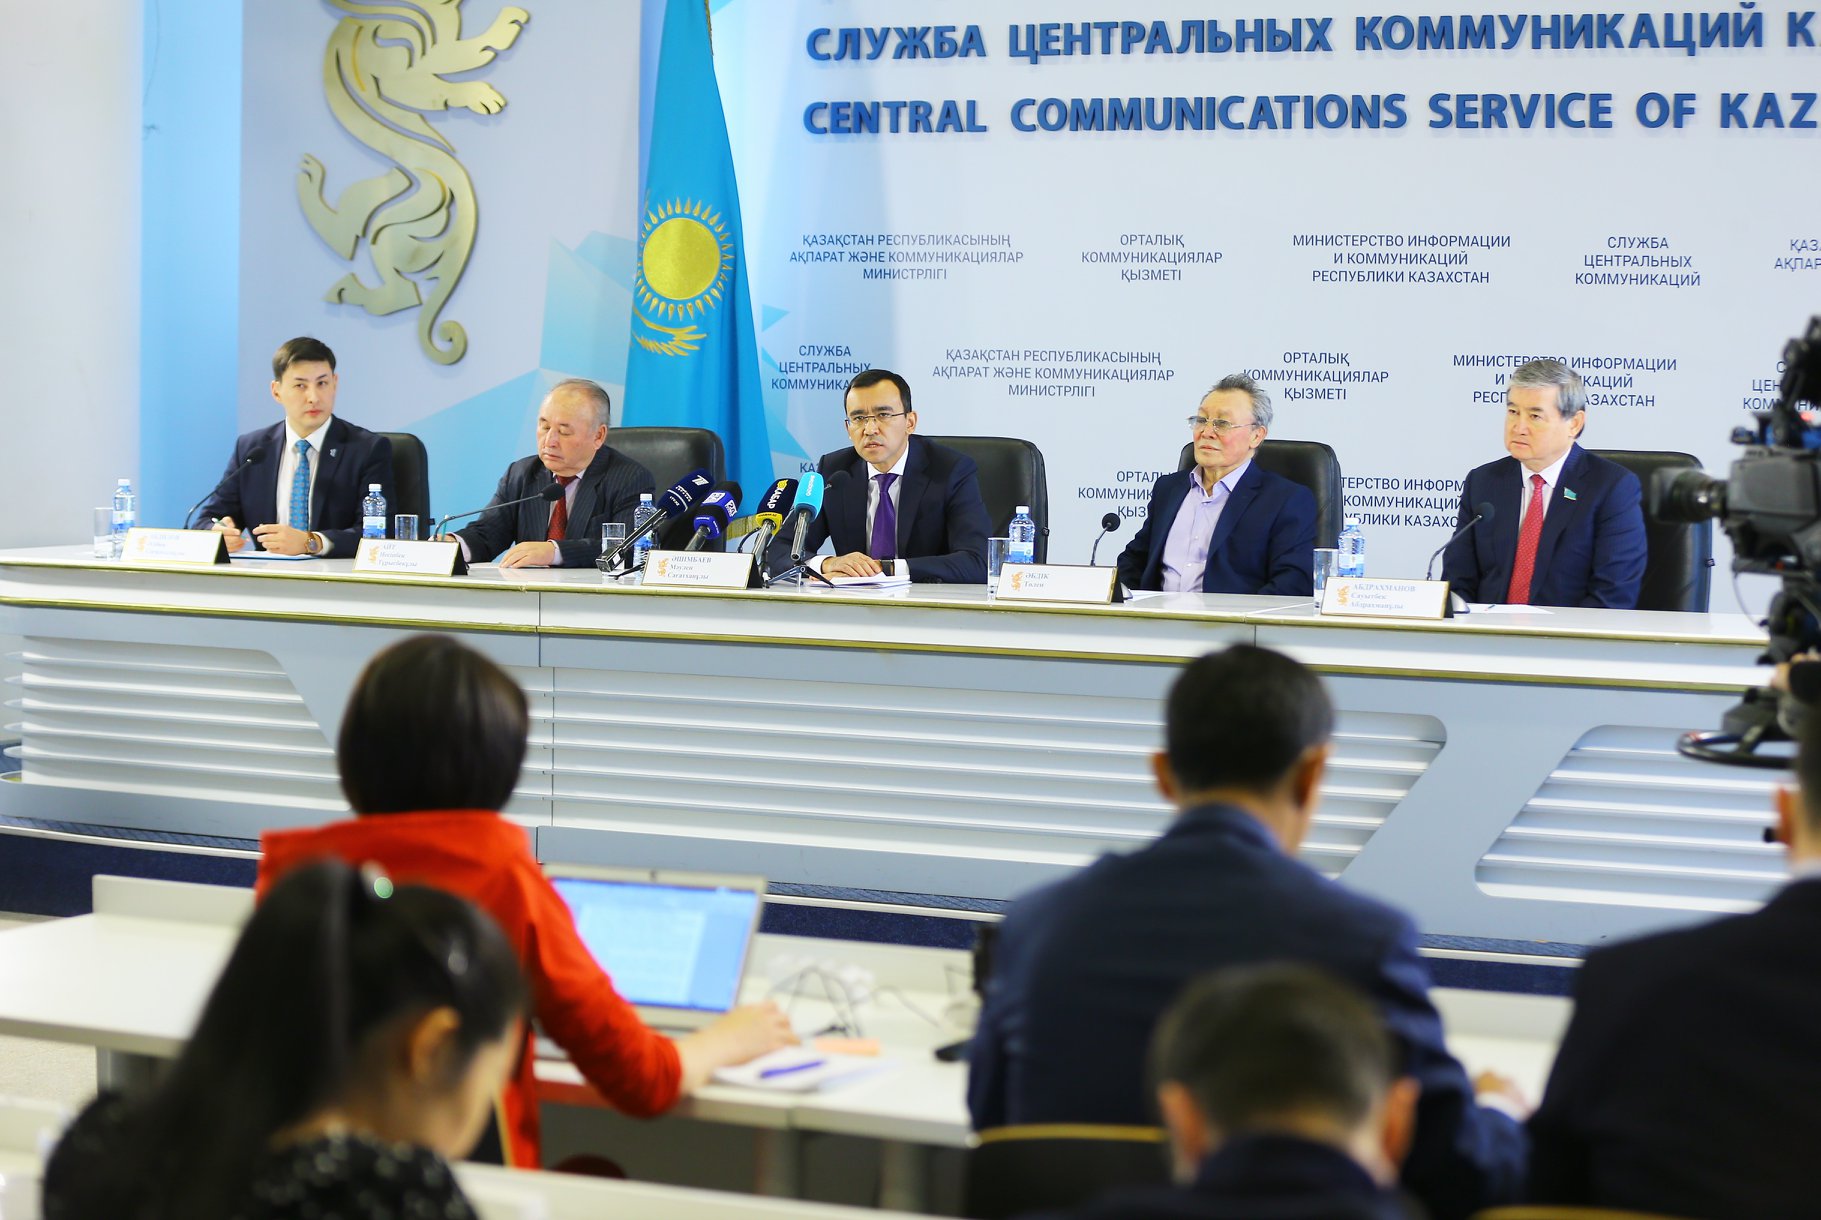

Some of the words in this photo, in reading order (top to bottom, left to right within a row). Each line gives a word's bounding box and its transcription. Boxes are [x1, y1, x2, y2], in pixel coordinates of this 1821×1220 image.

[806, 25, 987, 61] СЛУЖБА
[1009, 18, 1333, 65] ЦЕНТРАЛЬНЫХ
[1356, 2, 1763, 56] КОММУНИКАЦИЙ
[1788, 11, 1821, 47] К
[803, 100, 988, 135] CENTRAL
[1011, 94, 1407, 132] COMMUNICATIONS
[1429, 92, 1612, 128] SERVICE
[1636, 92, 1696, 128] OF
[1721, 93, 1818, 128] KAZ
[803, 235, 874, 247] ҚАЗАҚСТАН
[878, 235, 1011, 247] РЕСПУБЛИКАСЫНЫҢ
[1121, 234, 1184, 248] ОРТАЛЫҚ
[1294, 235, 1403, 246] МИНИСТЕРСТВО
[1408, 235, 1510, 250] ИНФОРМАЦИИ
[1608, 237, 1668, 248] СЛУЖБА
[1790, 239, 1821, 253] ҚАЗ
[790, 251, 845, 264] АҚПАРАТ
[849, 252, 885, 262] ЖӘНЕ
[889, 252, 1023, 264] КОММУНИКАЦИЯЛАР
[1082, 252, 1222, 265] КОММУНИКАЦИЯЛАР
[1334, 253, 1342, 264] И
[1348, 251, 1467, 267] КОММУНИКАЦИЙ
[1585, 255, 1691, 269] ЦЕНТРАЛЬНЫХ
[863, 268, 947, 280] МИНИСТРЛІГІ
[1122, 269, 1181, 283] ҚЫЗМЕТІ
[1313, 270, 1403, 282] РЕСПУБЛИКИ
[1409, 271, 1489, 283] КАЗАХСТАН
[1576, 271, 1700, 288] КОММУНИКАЦИЙ
[799, 345, 851, 356] СЛУЖБА
[947, 349, 1019, 363] ҚАЗАҚСТАН
[1024, 350, 1161, 365] РЕСПУБЛИКАСЫНЫҢ
[1284, 352, 1349, 366] ОРТАЛЫҚ
[1571, 357, 1677, 372] ИНФОРМАЦИИ
[933, 366, 990, 379] АҚПАРАТ
[993, 367, 1031, 378] ЖӘНЕ
[1035, 368, 1174, 382] КОММУНИКАЦИЯЛАР
[1496, 374, 1504, 385] И
[771, 379, 849, 390] КОММУНИКА
[1009, 385, 1094, 397] МИНИСТРЛІГІ
[1285, 388, 1346, 401] ҚЫЗМЕТІ
[1078, 487, 1152, 500] КОММУНИК
[1117, 505, 1146, 518] ҚЫЗ
